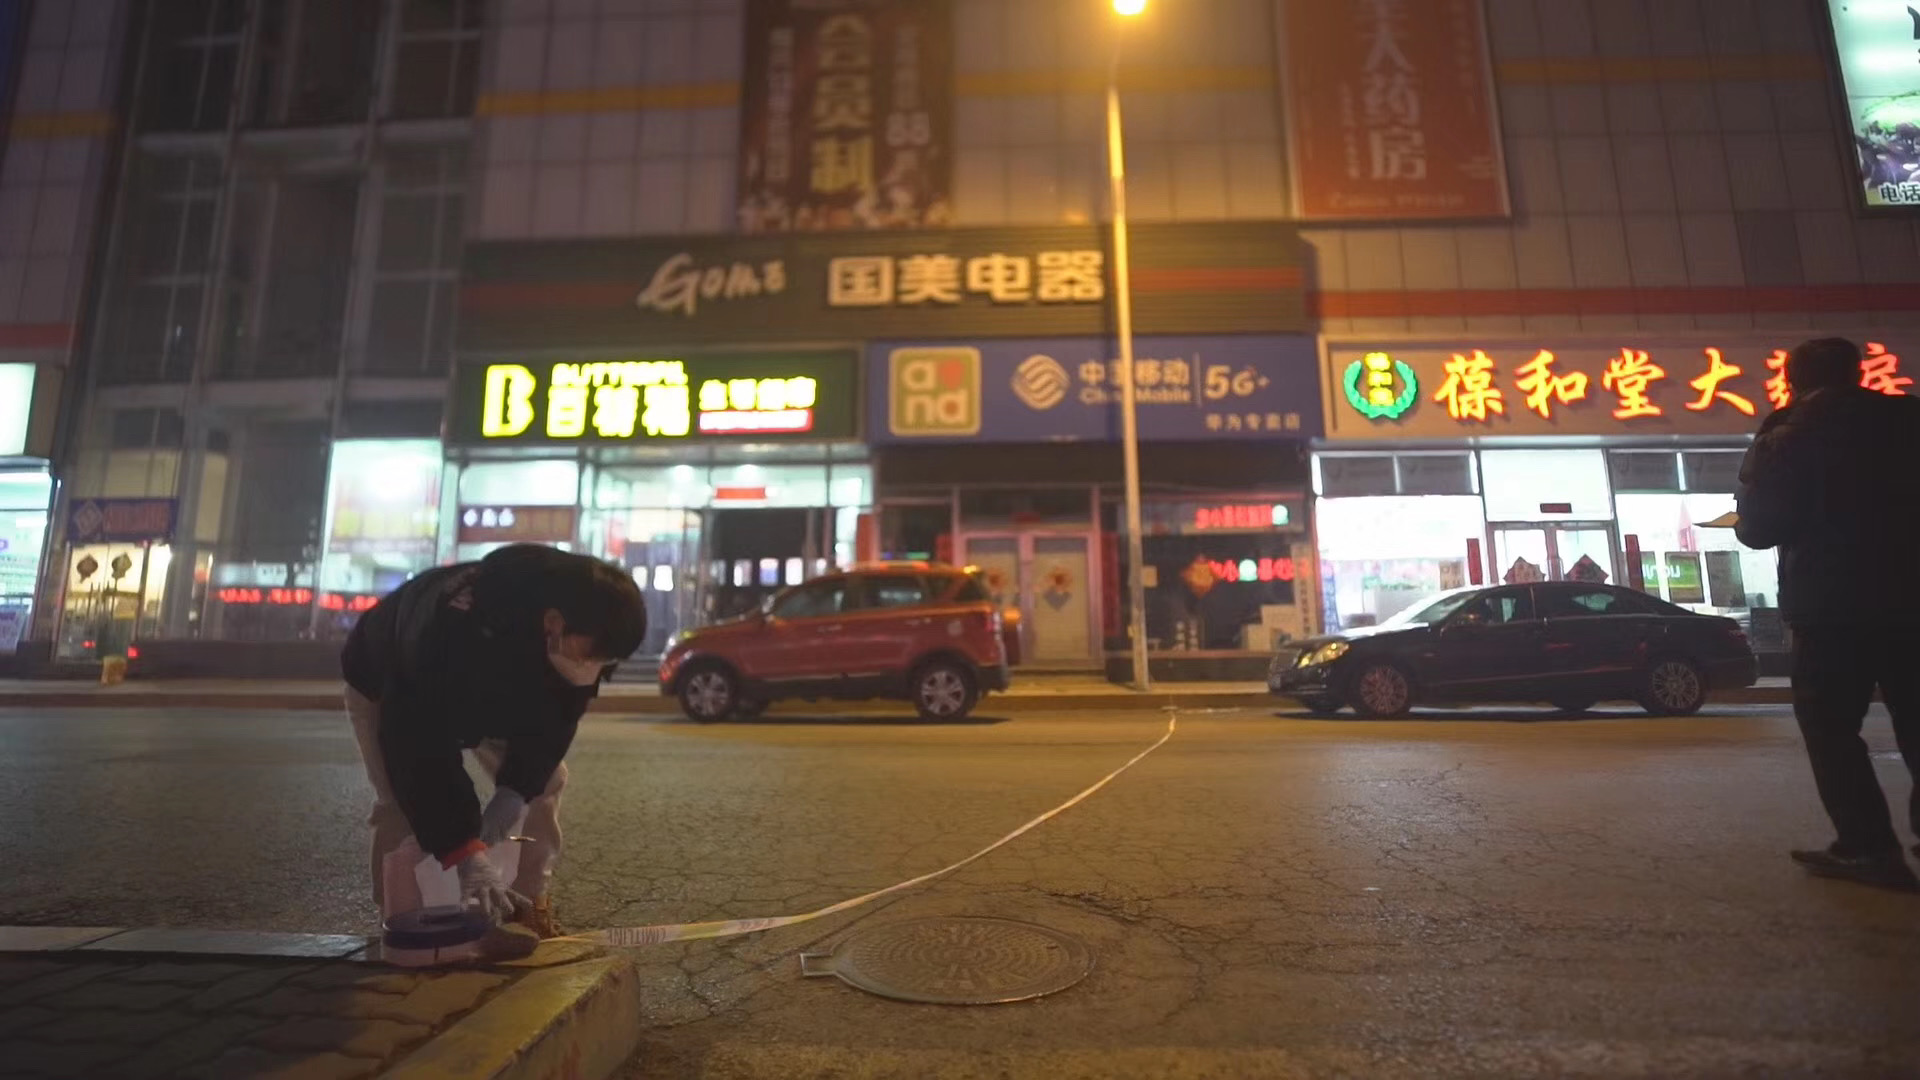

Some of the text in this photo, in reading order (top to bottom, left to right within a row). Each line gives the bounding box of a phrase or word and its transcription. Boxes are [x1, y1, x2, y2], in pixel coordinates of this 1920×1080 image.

[1881, 182, 1920, 203] 电话
[828, 250, 1104, 306] 国美电器
